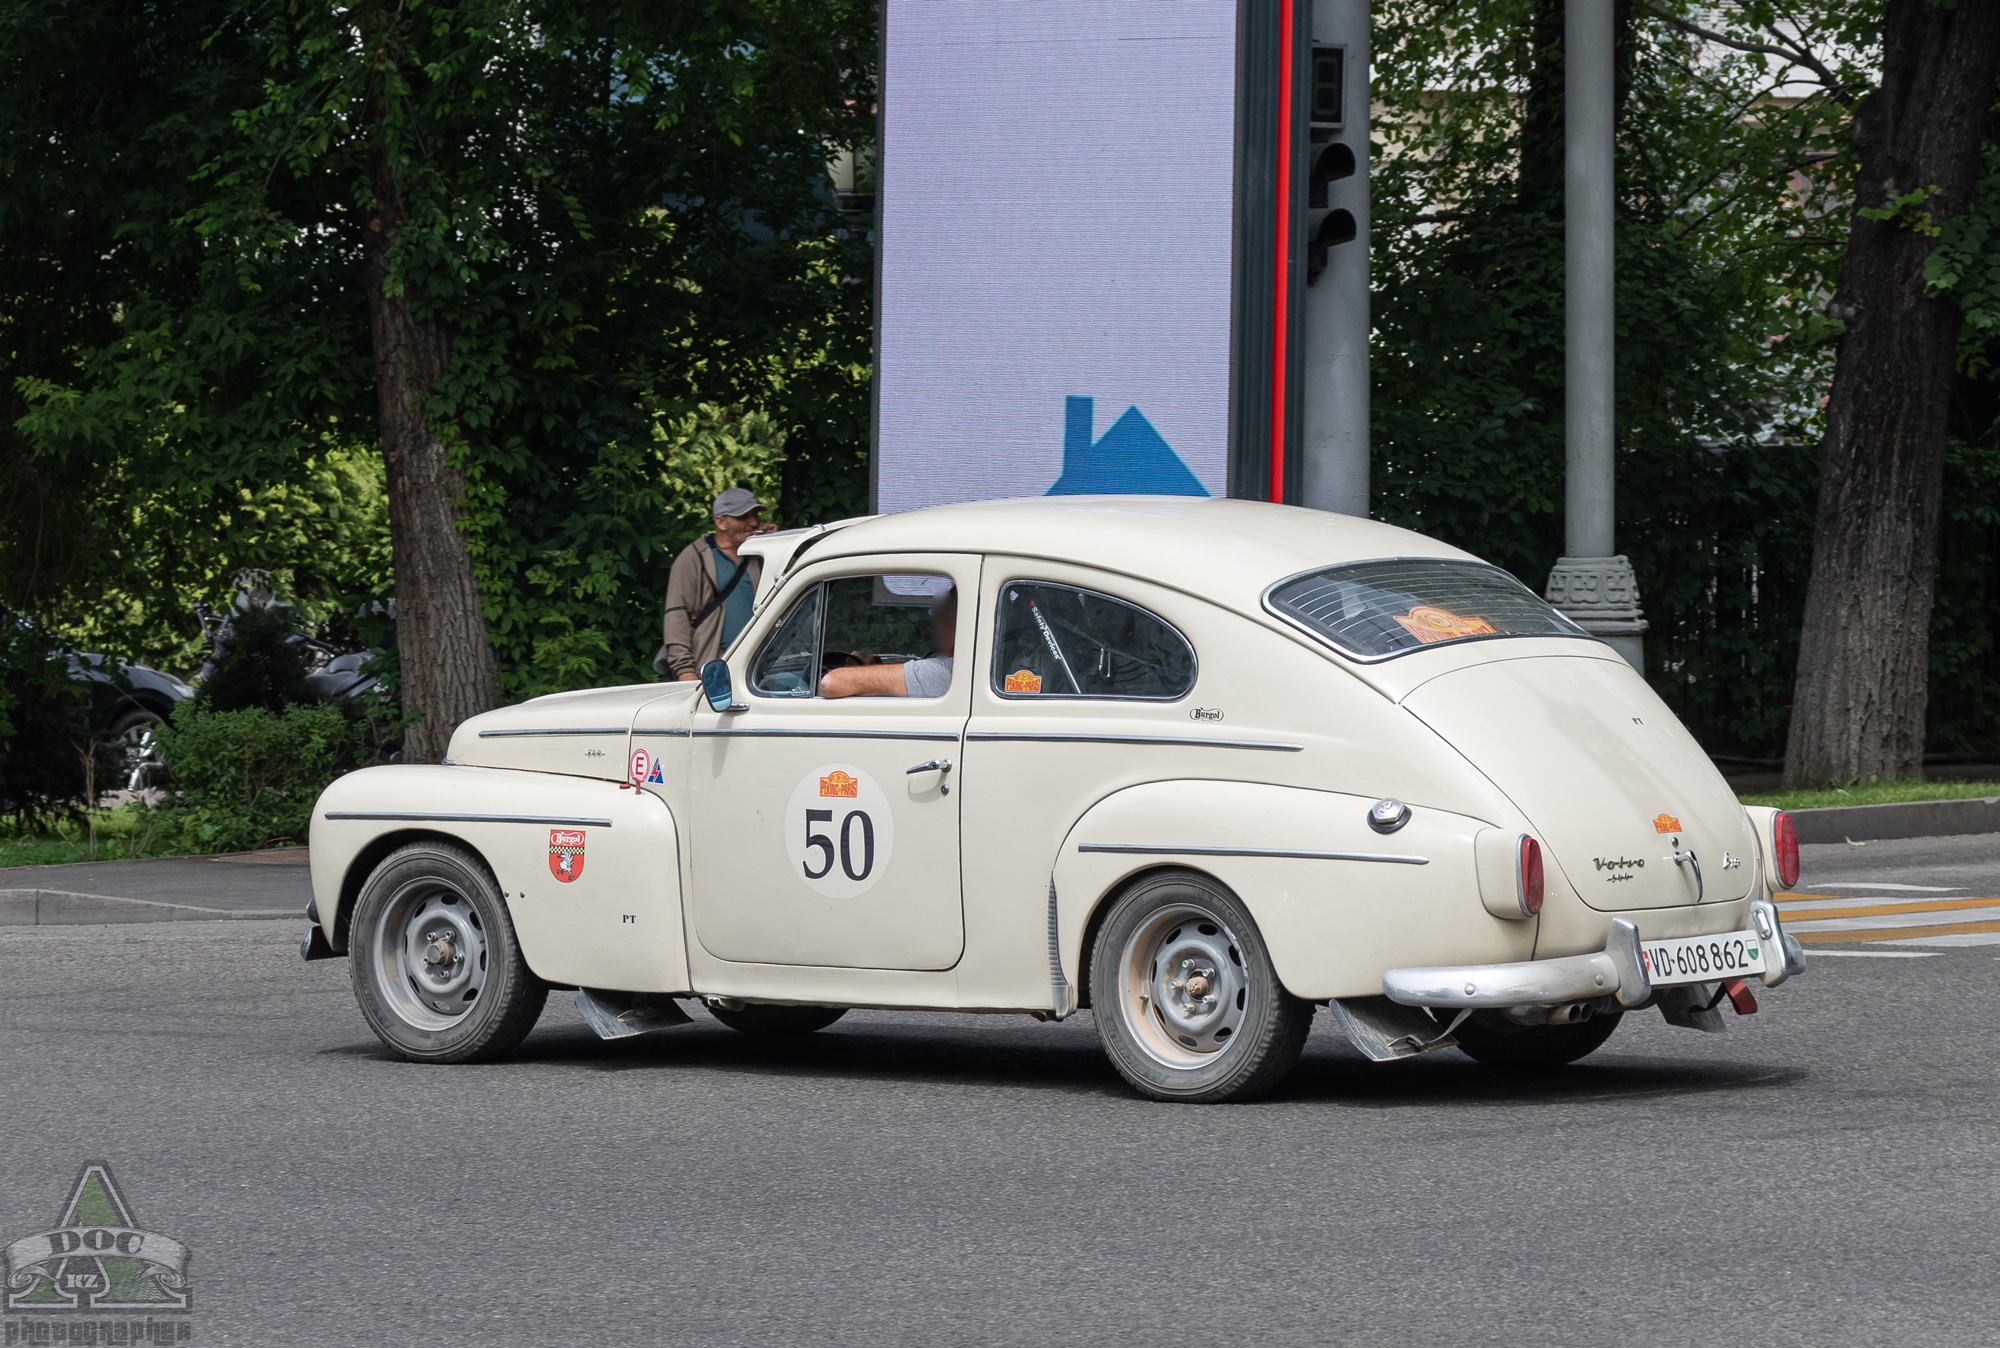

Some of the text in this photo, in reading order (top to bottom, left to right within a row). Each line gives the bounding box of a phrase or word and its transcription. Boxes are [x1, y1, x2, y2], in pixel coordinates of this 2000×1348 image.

[1194, 708, 1220, 720] Burgol
[635, 756, 644, 776] E
[555, 833, 581, 844] Burgol
[803, 808, 875, 881] 50
[1592, 855, 1645, 871] Volvo
[622, 914, 637, 924] PT
